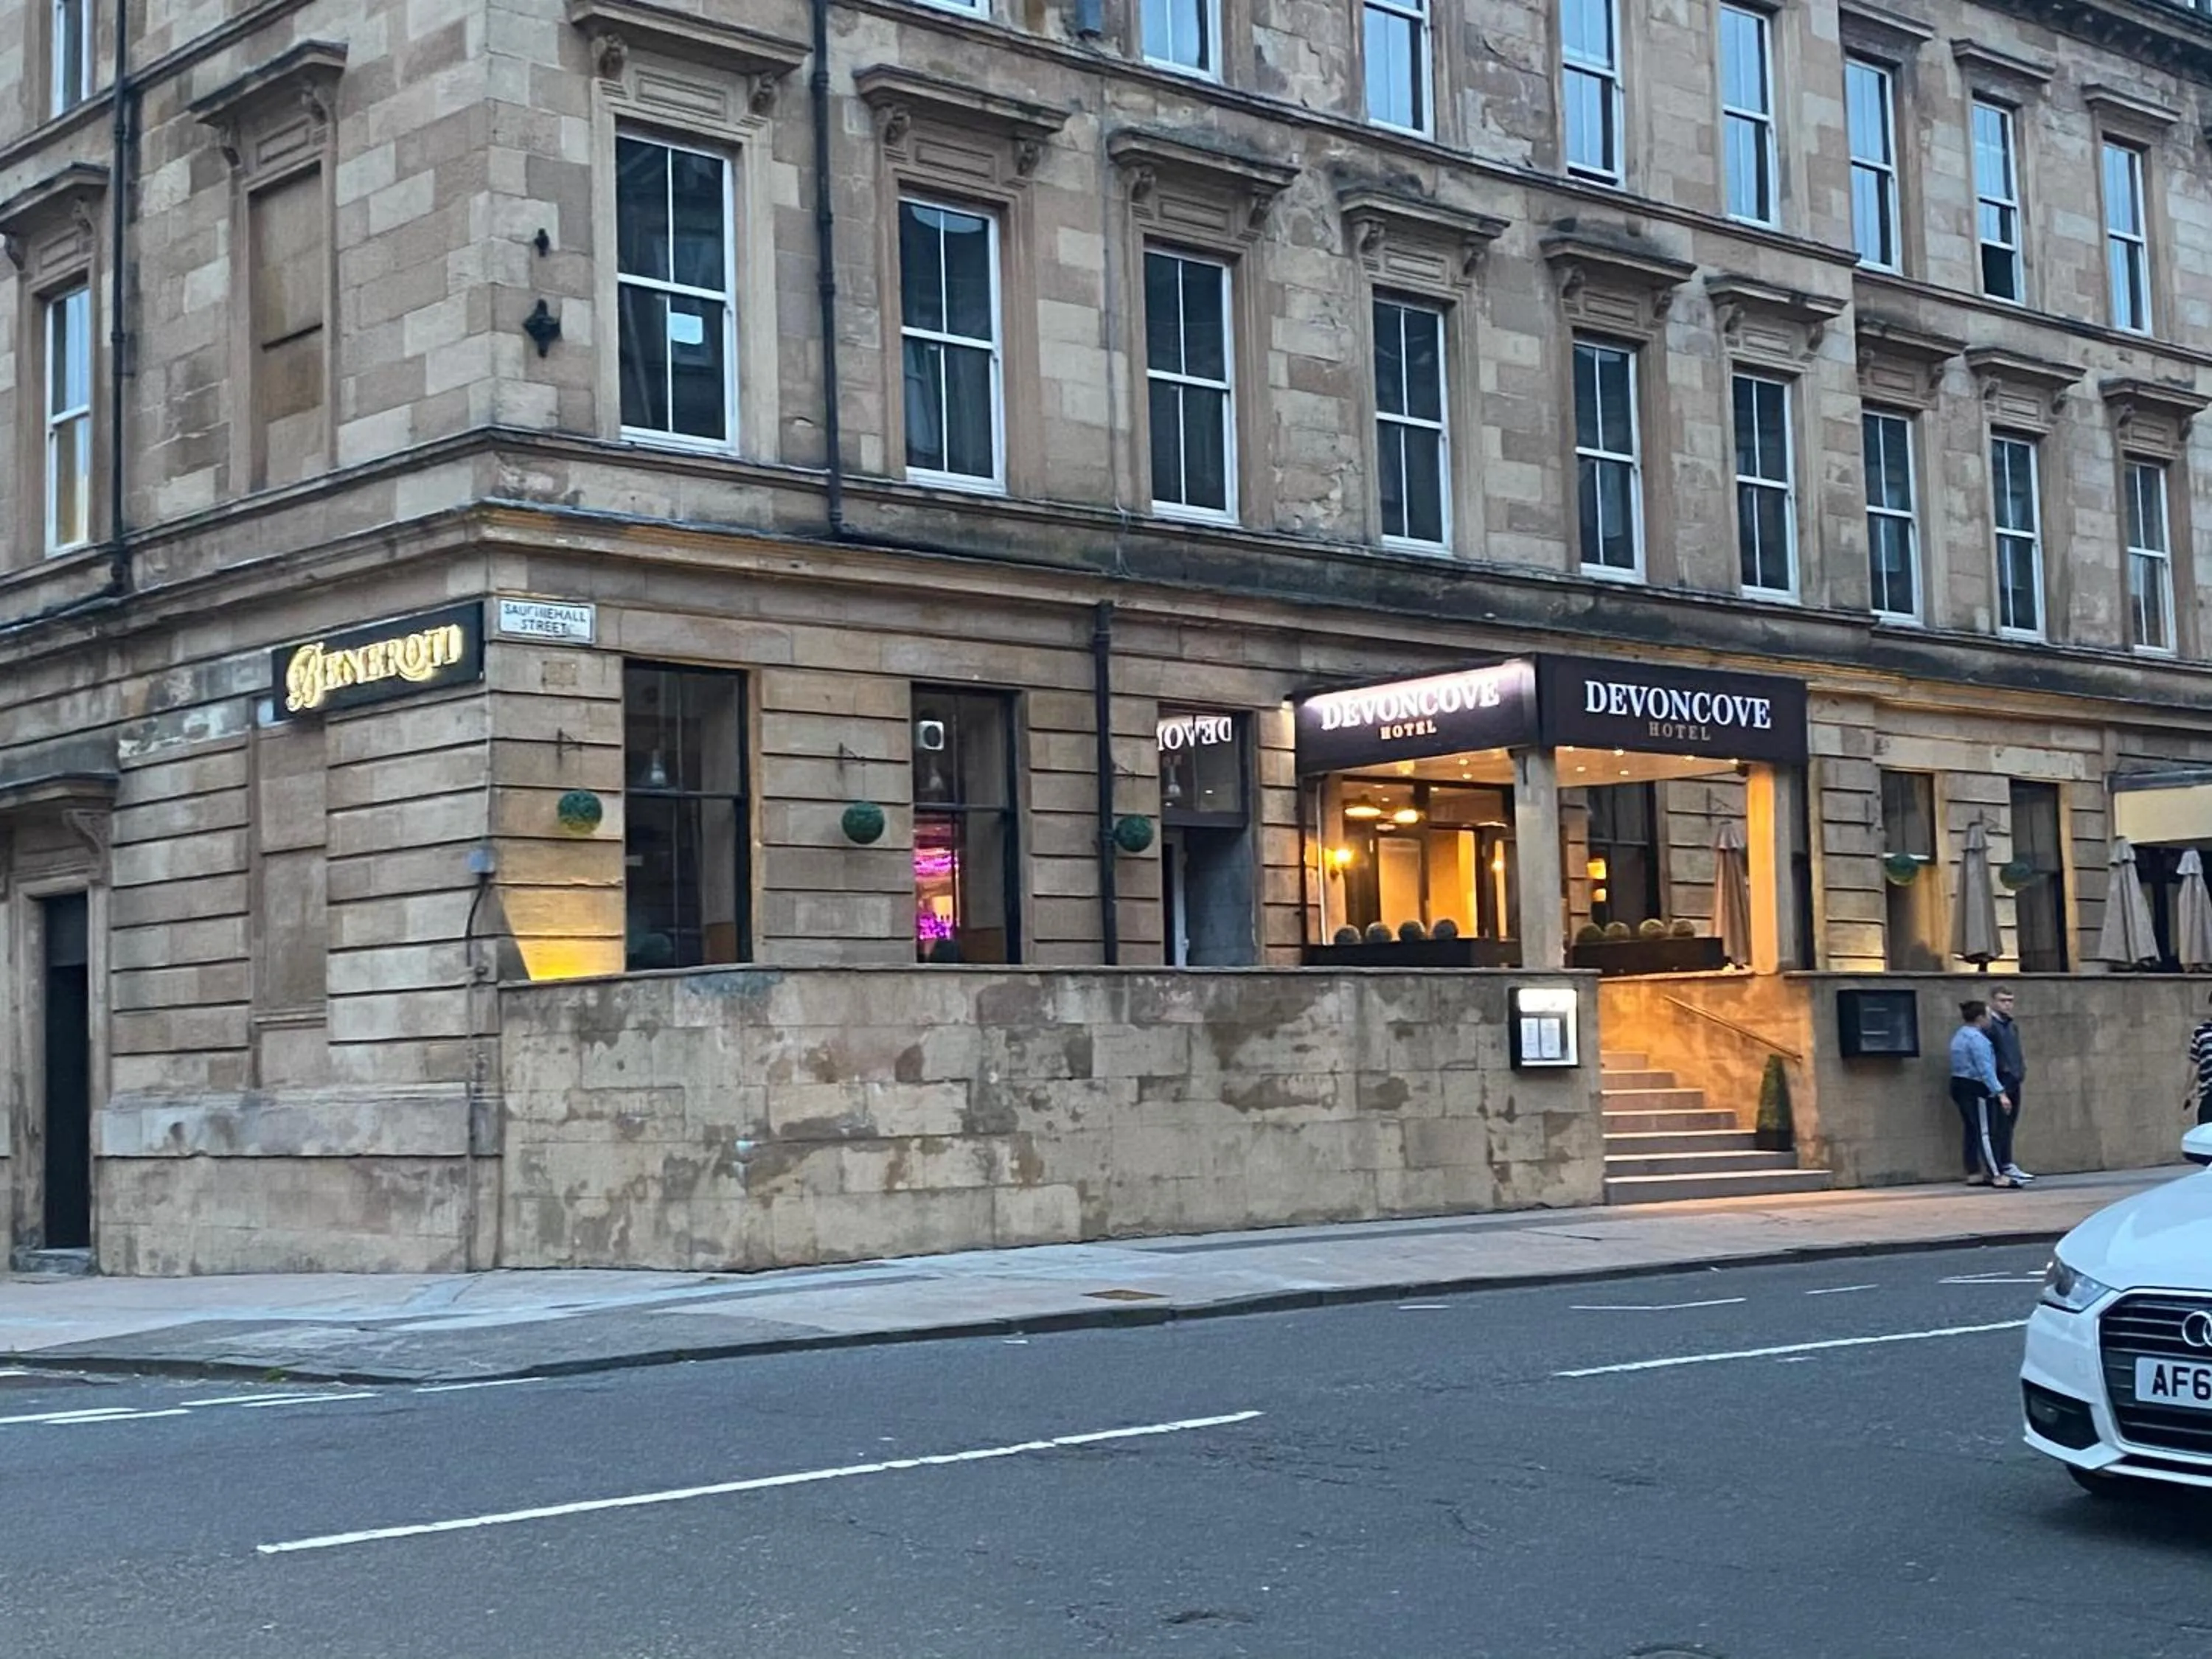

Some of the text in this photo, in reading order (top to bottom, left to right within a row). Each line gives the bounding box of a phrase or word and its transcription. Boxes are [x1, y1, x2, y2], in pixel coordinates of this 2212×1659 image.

[521, 619, 567, 633] STREET
[1321, 680, 1500, 730] DEVONCOVE
[1585, 681, 1772, 729] DEVONCOVE
[1380, 720, 1437, 740] HOTEL
[1649, 721, 1711, 741] HOTEL
[2152, 1364, 2211, 1400] AF6
